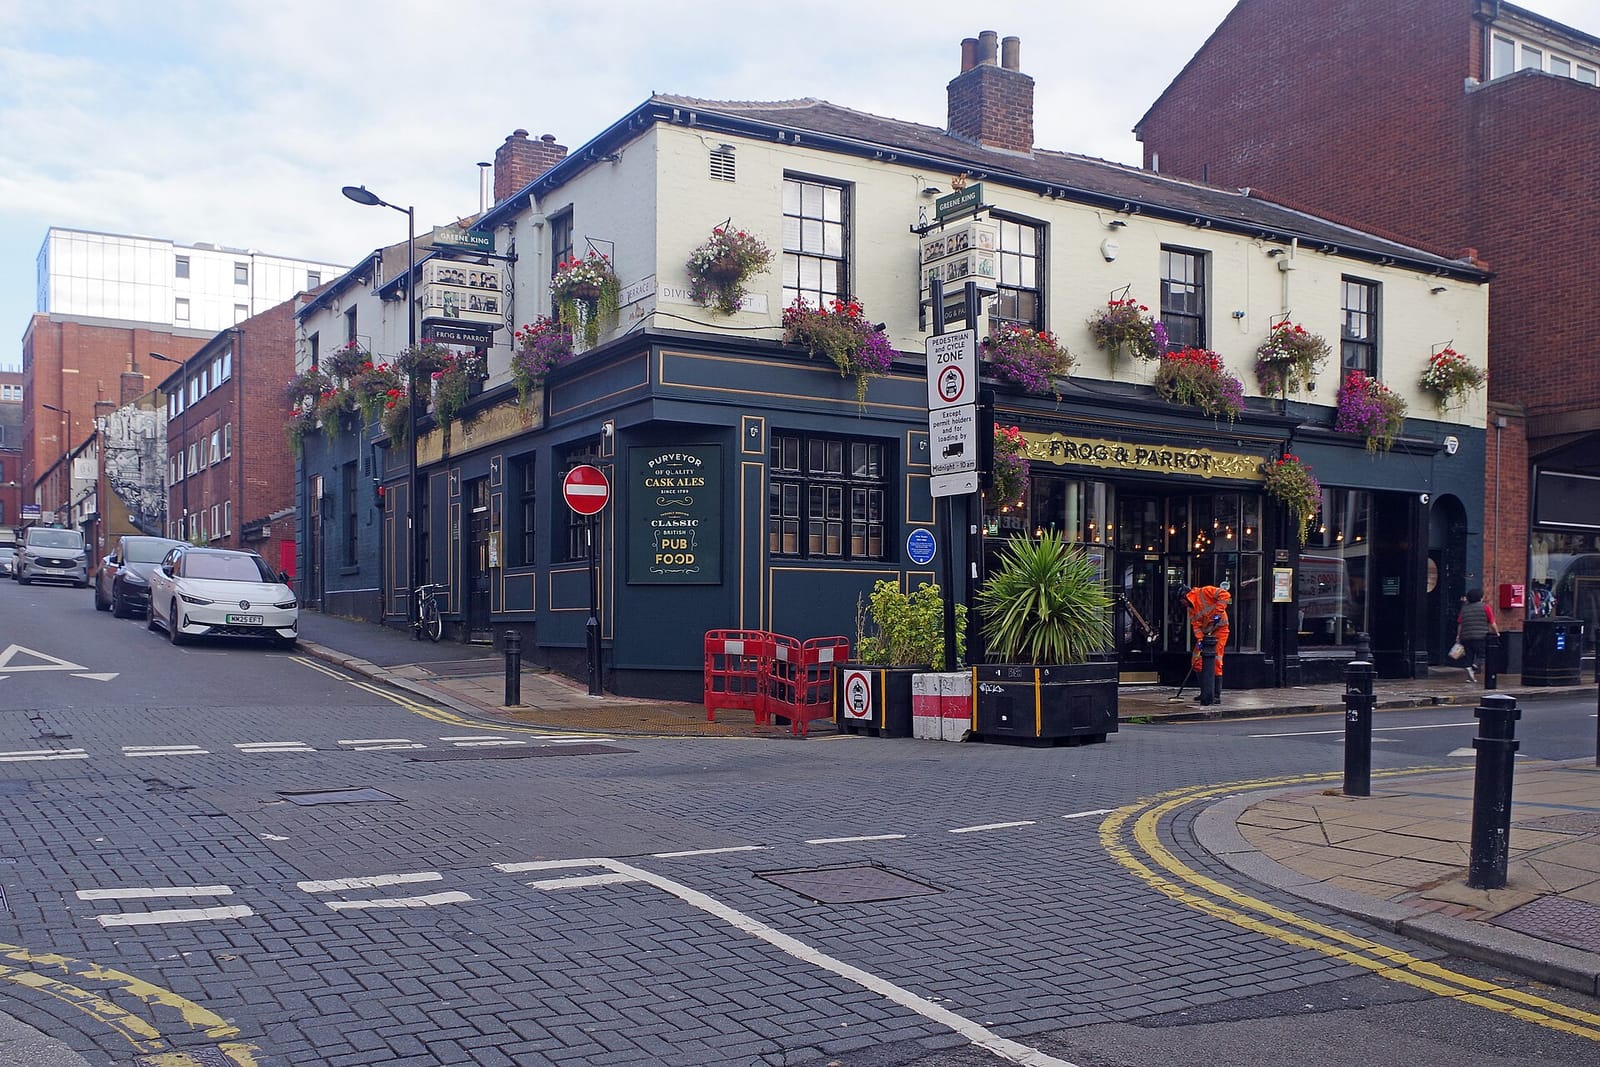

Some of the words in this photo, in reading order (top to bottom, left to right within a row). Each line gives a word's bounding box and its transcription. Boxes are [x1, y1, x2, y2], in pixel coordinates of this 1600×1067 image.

[940, 197, 960, 211] GREENE
[961, 192, 976, 203] KING
[440, 232, 469, 242] GREENE
[470, 236, 489, 245] KING
[436, 331, 455, 339] FROG
[463, 334, 489, 343] PARROT
[932, 333, 969, 346] PEDESTRIAN
[946, 341, 965, 351] CYCLE
[937, 350, 964, 364] ZONE
[942, 410, 961, 419] Except
[932, 419, 951, 429] permit
[951, 416, 972, 425] holders
[937, 434, 958, 443] loading
[959, 432, 967, 440] by
[648, 453, 702, 468] PURVEYOR
[1049, 440, 1107, 461] FROG
[1115, 447, 1129, 463] &
[1135, 447, 1213, 472] PARROT
[932, 463, 955, 472] Midnight
[645, 478, 675, 487] CASK
[676, 477, 705, 487] ALES
[651, 519, 699, 527] CLASSIC
[661, 538, 688, 550] PUB
[655, 553, 695, 565] FOOD
